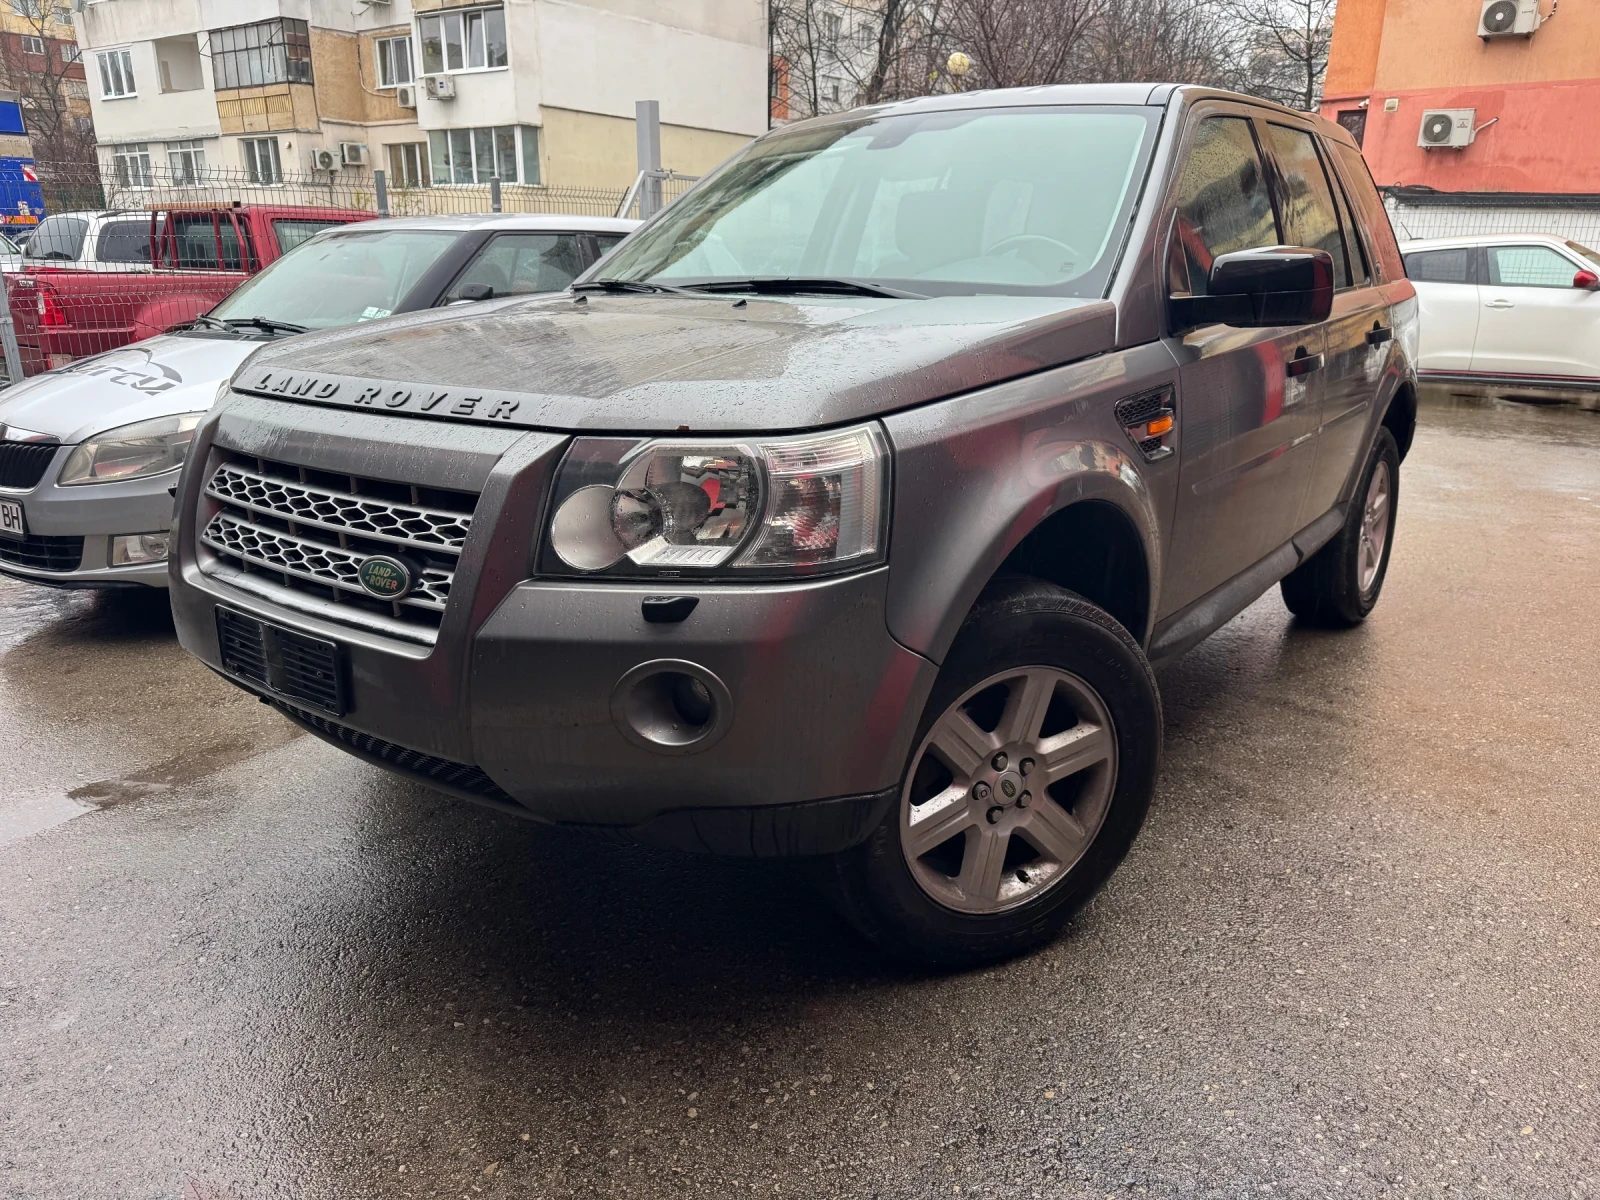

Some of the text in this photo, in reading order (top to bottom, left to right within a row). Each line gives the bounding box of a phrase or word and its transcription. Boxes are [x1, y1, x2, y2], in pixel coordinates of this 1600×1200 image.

[253, 372, 520, 419] LAND ROVER
[1, 504, 21, 530] BH
[368, 564, 391, 577] LAND
[369, 575, 398, 590] ROVER
